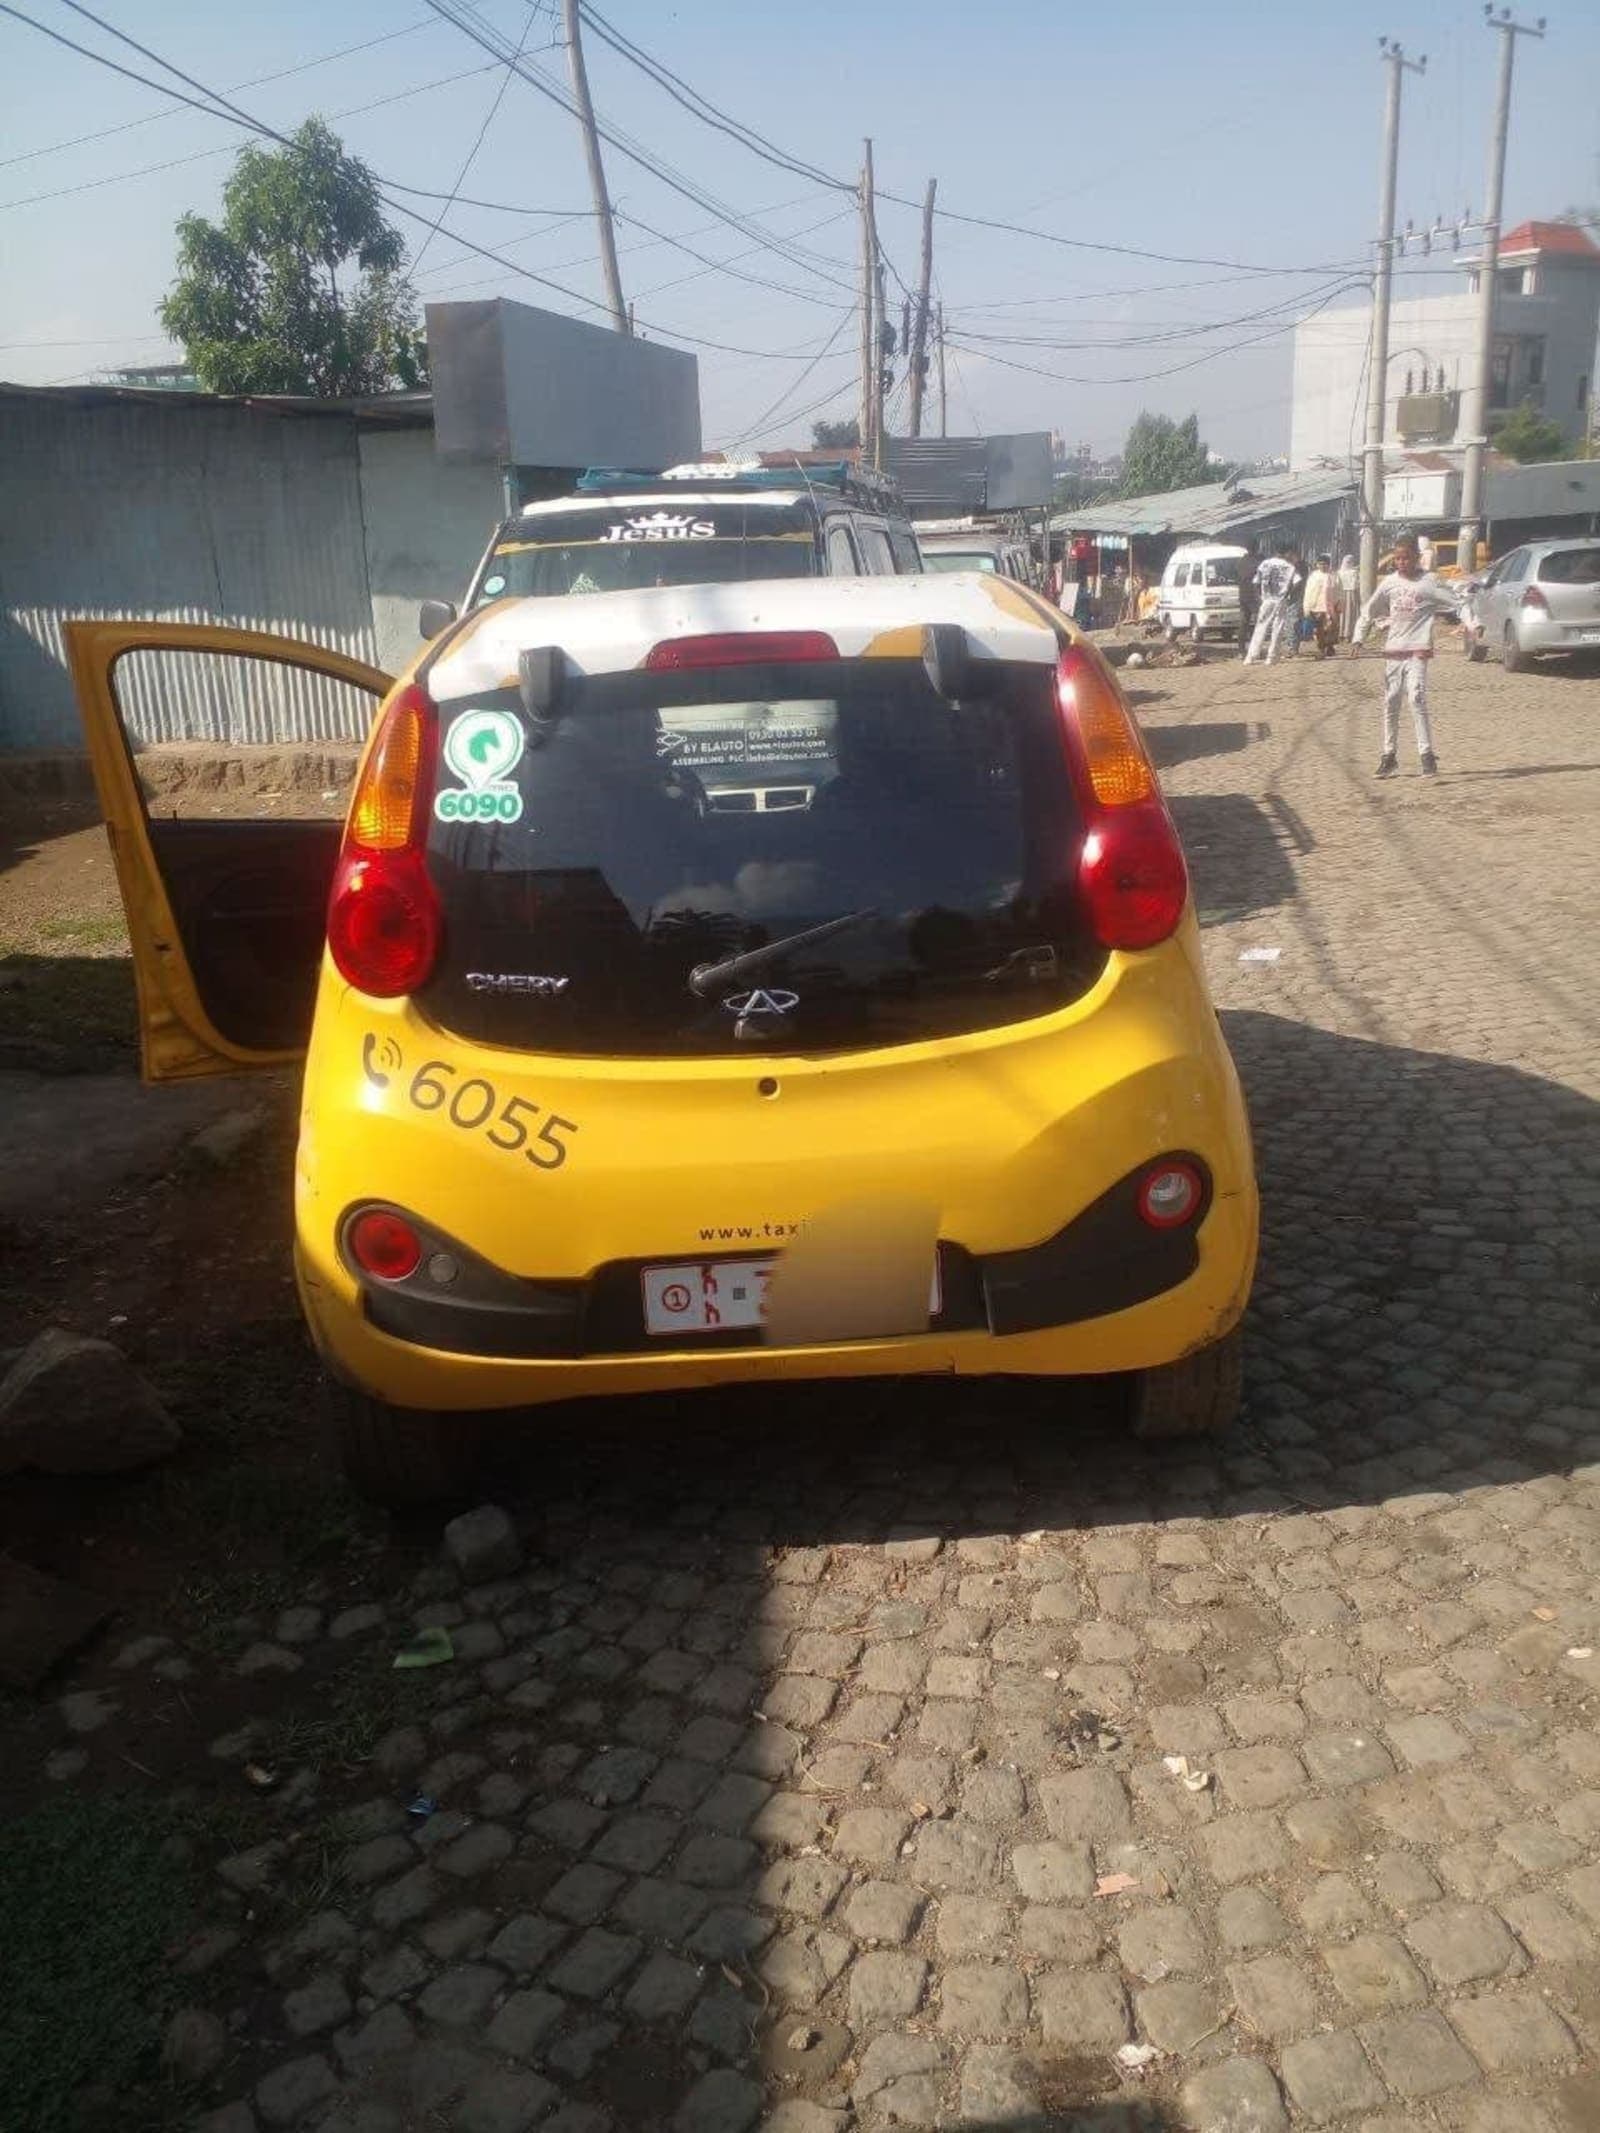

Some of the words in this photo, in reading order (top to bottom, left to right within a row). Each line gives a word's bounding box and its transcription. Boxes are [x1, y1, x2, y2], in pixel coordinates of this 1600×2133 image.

[701, 740, 744, 753] ELAUTO
[440, 792, 519, 819] 6090
[465, 972, 569, 994] CHERY
[409, 1060, 579, 1170] 6055
